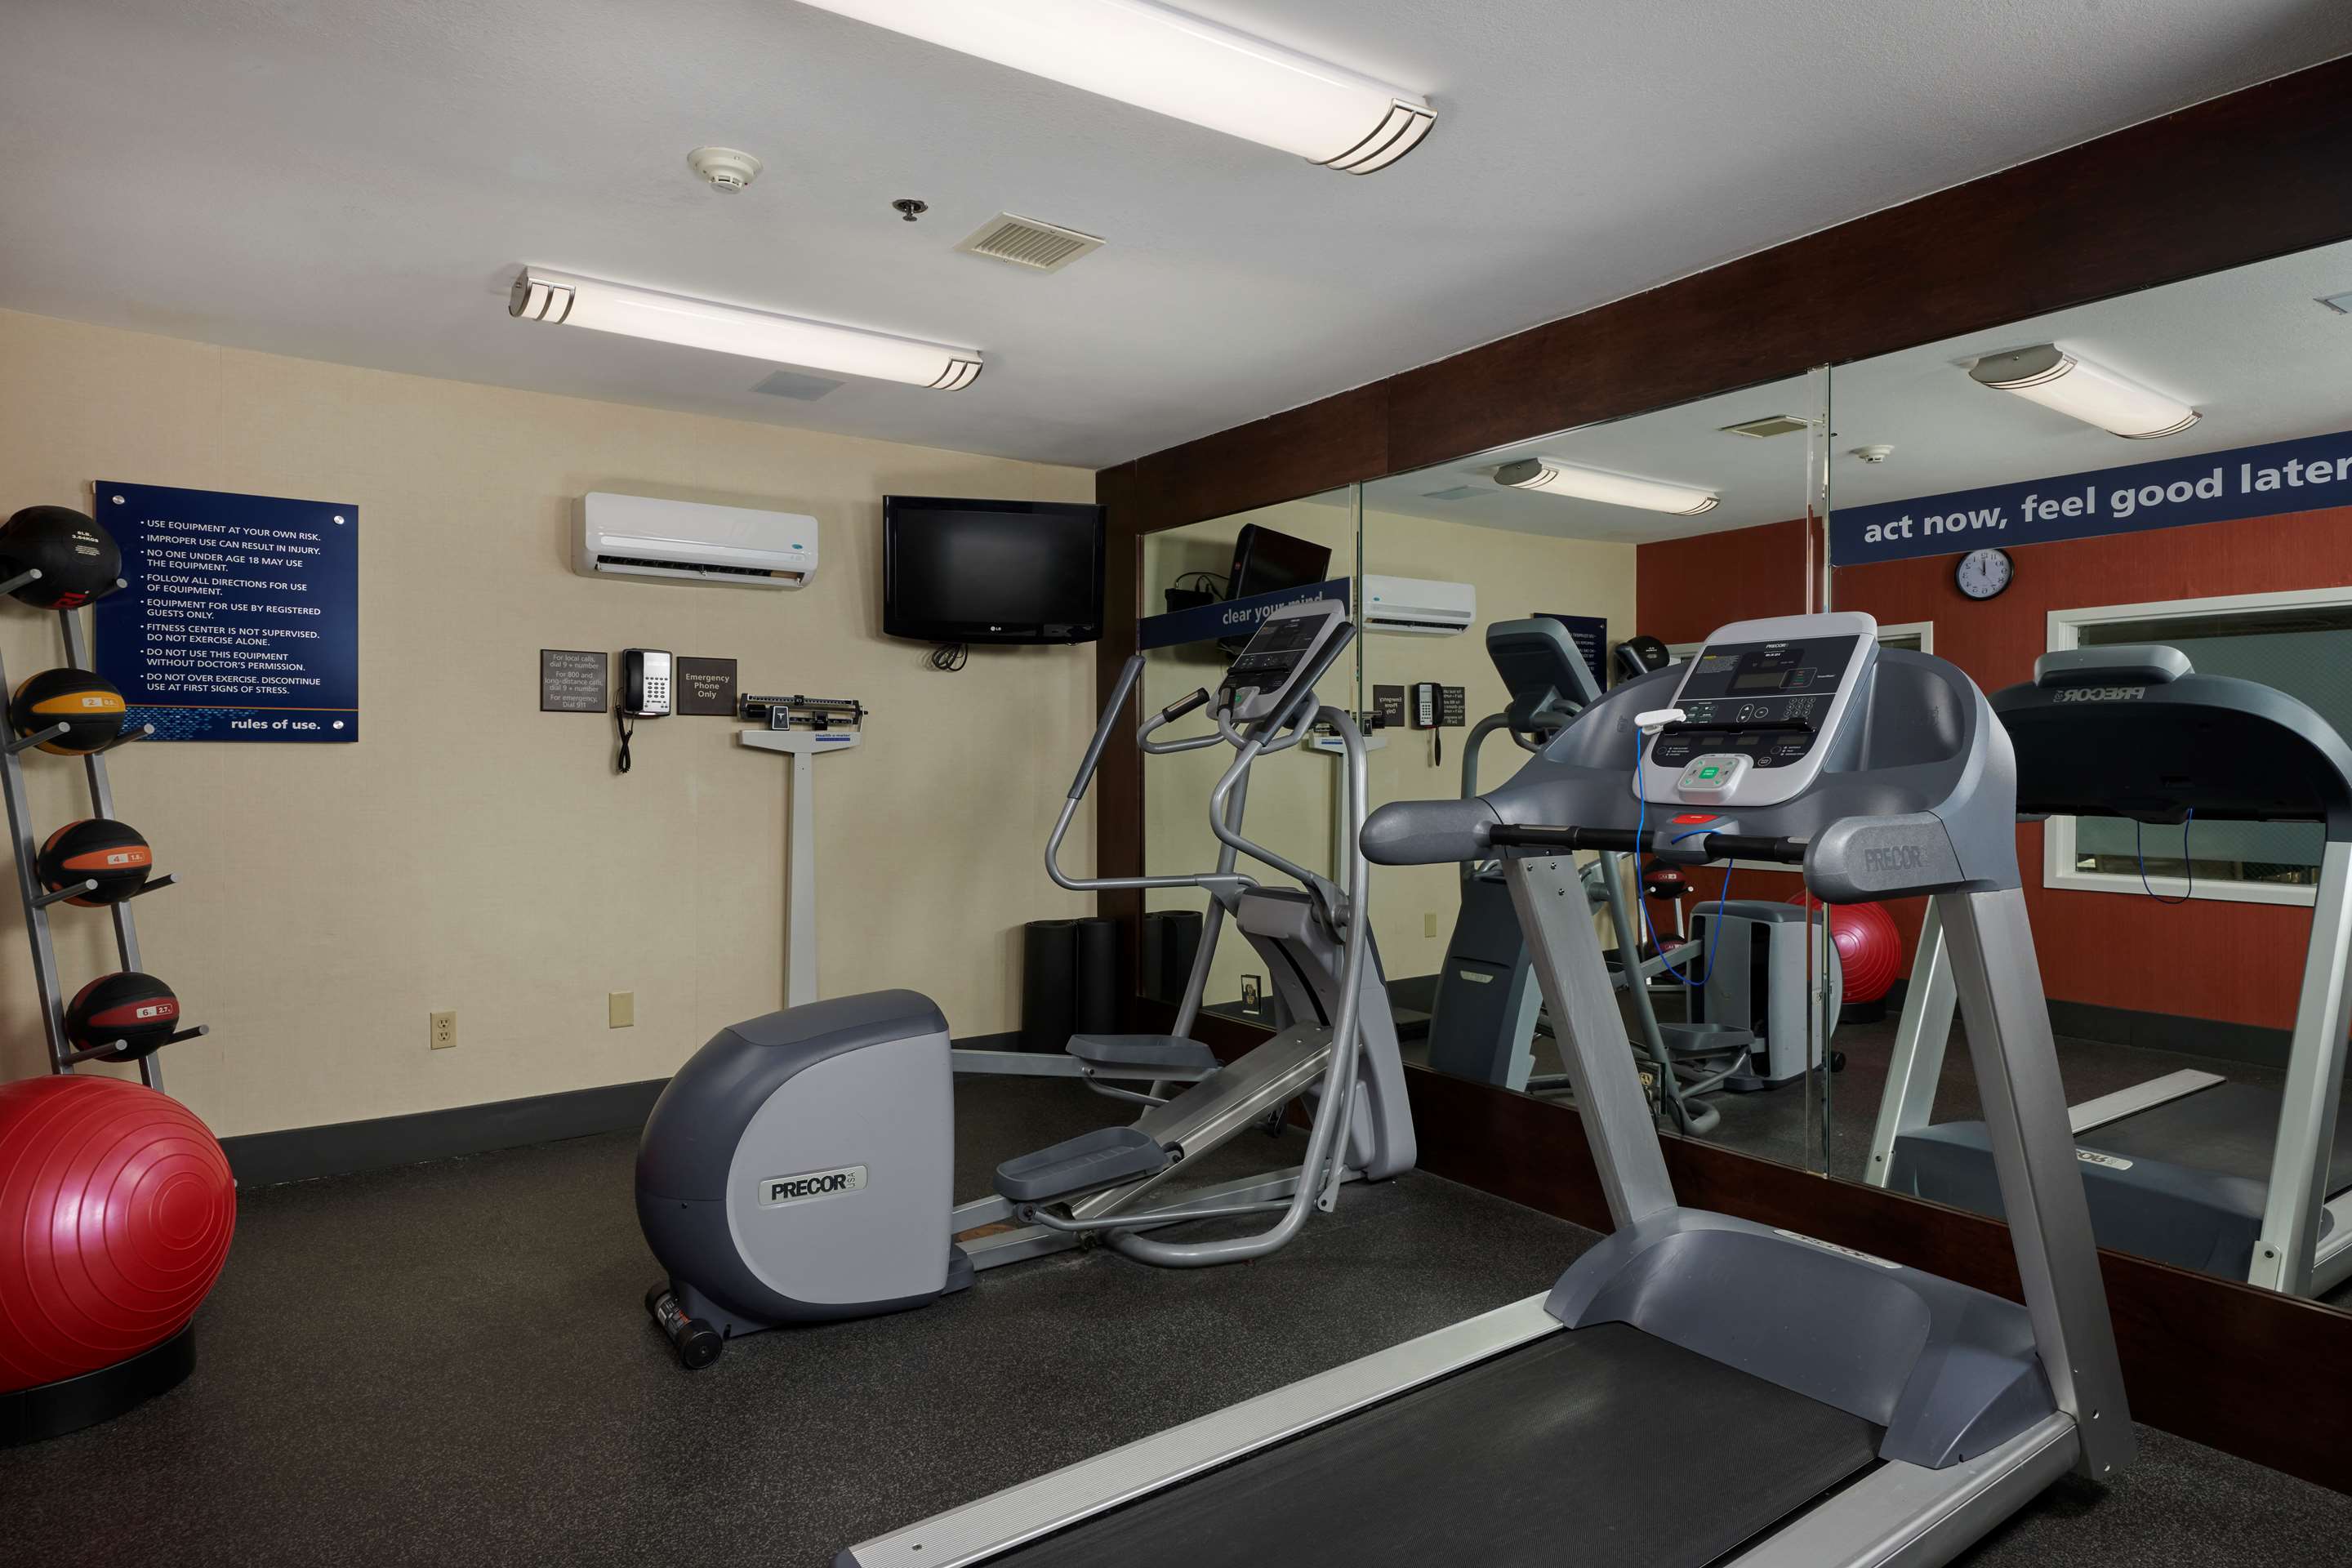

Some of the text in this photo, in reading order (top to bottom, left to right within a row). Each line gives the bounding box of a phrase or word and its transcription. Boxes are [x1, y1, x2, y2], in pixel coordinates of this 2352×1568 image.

[1864, 456, 2352, 543] act now, feel good later
[148, 519, 165, 528] USE
[169, 522, 226, 532] EQUIPMENT
[243, 528, 270, 536] YOUR
[273, 531, 296, 539] OWN
[299, 532, 320, 541] RISK.
[147, 535, 196, 545] IMPROPER
[242, 542, 274, 550] RESULT
[288, 546, 320, 555] INJURY.
[166, 550, 186, 559] ONE
[190, 552, 223, 561] UNDER
[170, 561, 228, 572] EQUIPMENT.
[147, 574, 189, 583] FOLLOW
[212, 578, 267, 588] DIRECTIONS
[291, 583, 307, 591] USE
[164, 586, 222, 595] EQUIPMENT.
[147, 599, 206, 608] EQUIPMENT
[266, 606, 320, 615] REGISTERED
[147, 609, 214, 619] GUESTS ONLY.
[1223, 603, 1285, 625] clear you
[147, 624, 185, 632] FITNESS
[188, 626, 225, 634] CENTER
[262, 630, 320, 639] SUPERVISED.
[189, 635, 233, 644] EXERCISE
[234, 652, 288, 660] EQUIPMENT
[147, 658, 305, 671] WITHOUT DOCTOR'S PERMISSION.
[262, 677, 320, 685] DISCONTINUE
[686, 674, 730, 683] Emergency
[697, 690, 717, 699] Only
[231, 719, 268, 728] rules
[272, 719, 287, 728] of
[1864, 845, 1921, 872] PRECOR
[847, 1171, 856, 1188] USA
[772, 1174, 846, 1200] PRECOR
